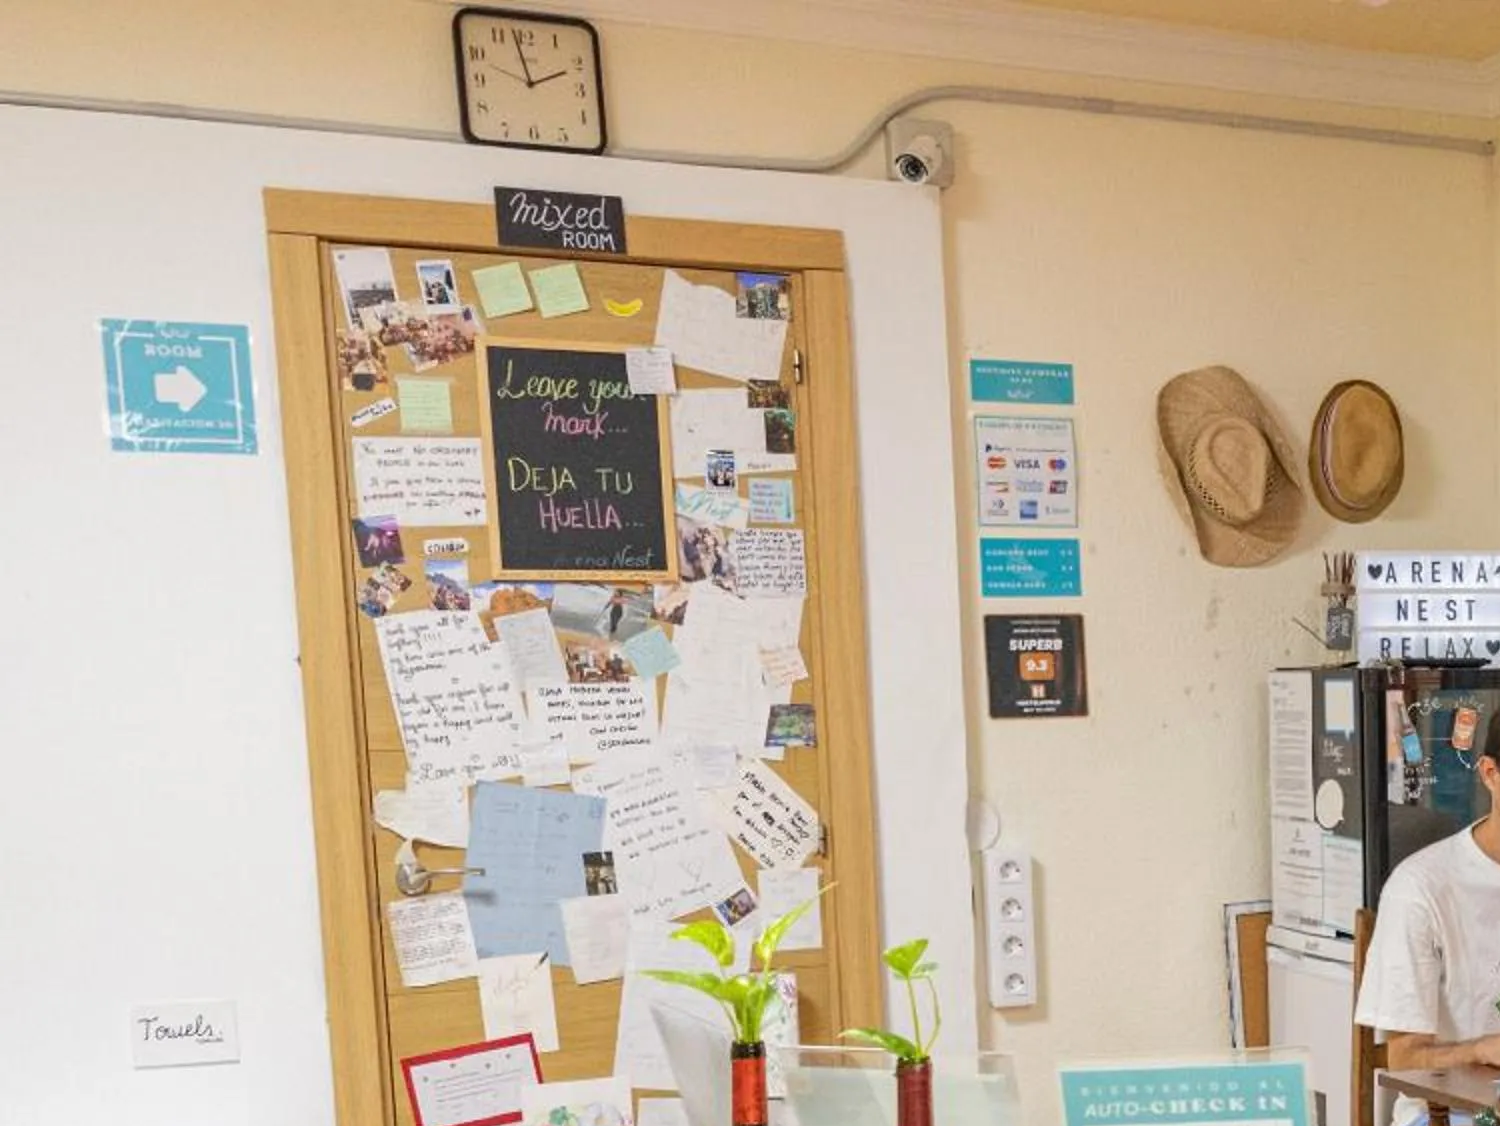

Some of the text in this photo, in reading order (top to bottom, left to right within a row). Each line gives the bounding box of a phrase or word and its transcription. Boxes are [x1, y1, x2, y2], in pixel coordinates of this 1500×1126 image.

[563, 231, 617, 252] ROOM
[496, 358, 647, 416] Leave you
[1014, 459, 1041, 470] VISA
[507, 456, 577, 498] DEJA
[595, 467, 634, 495] TU
[1386, 561, 1488, 583] ARENA
[1397, 599, 1476, 621] NEST
[1009, 638, 1063, 651] SUPERB
[1380, 637, 1475, 660] RELAX
[1258, 1095, 1287, 1111] IN
